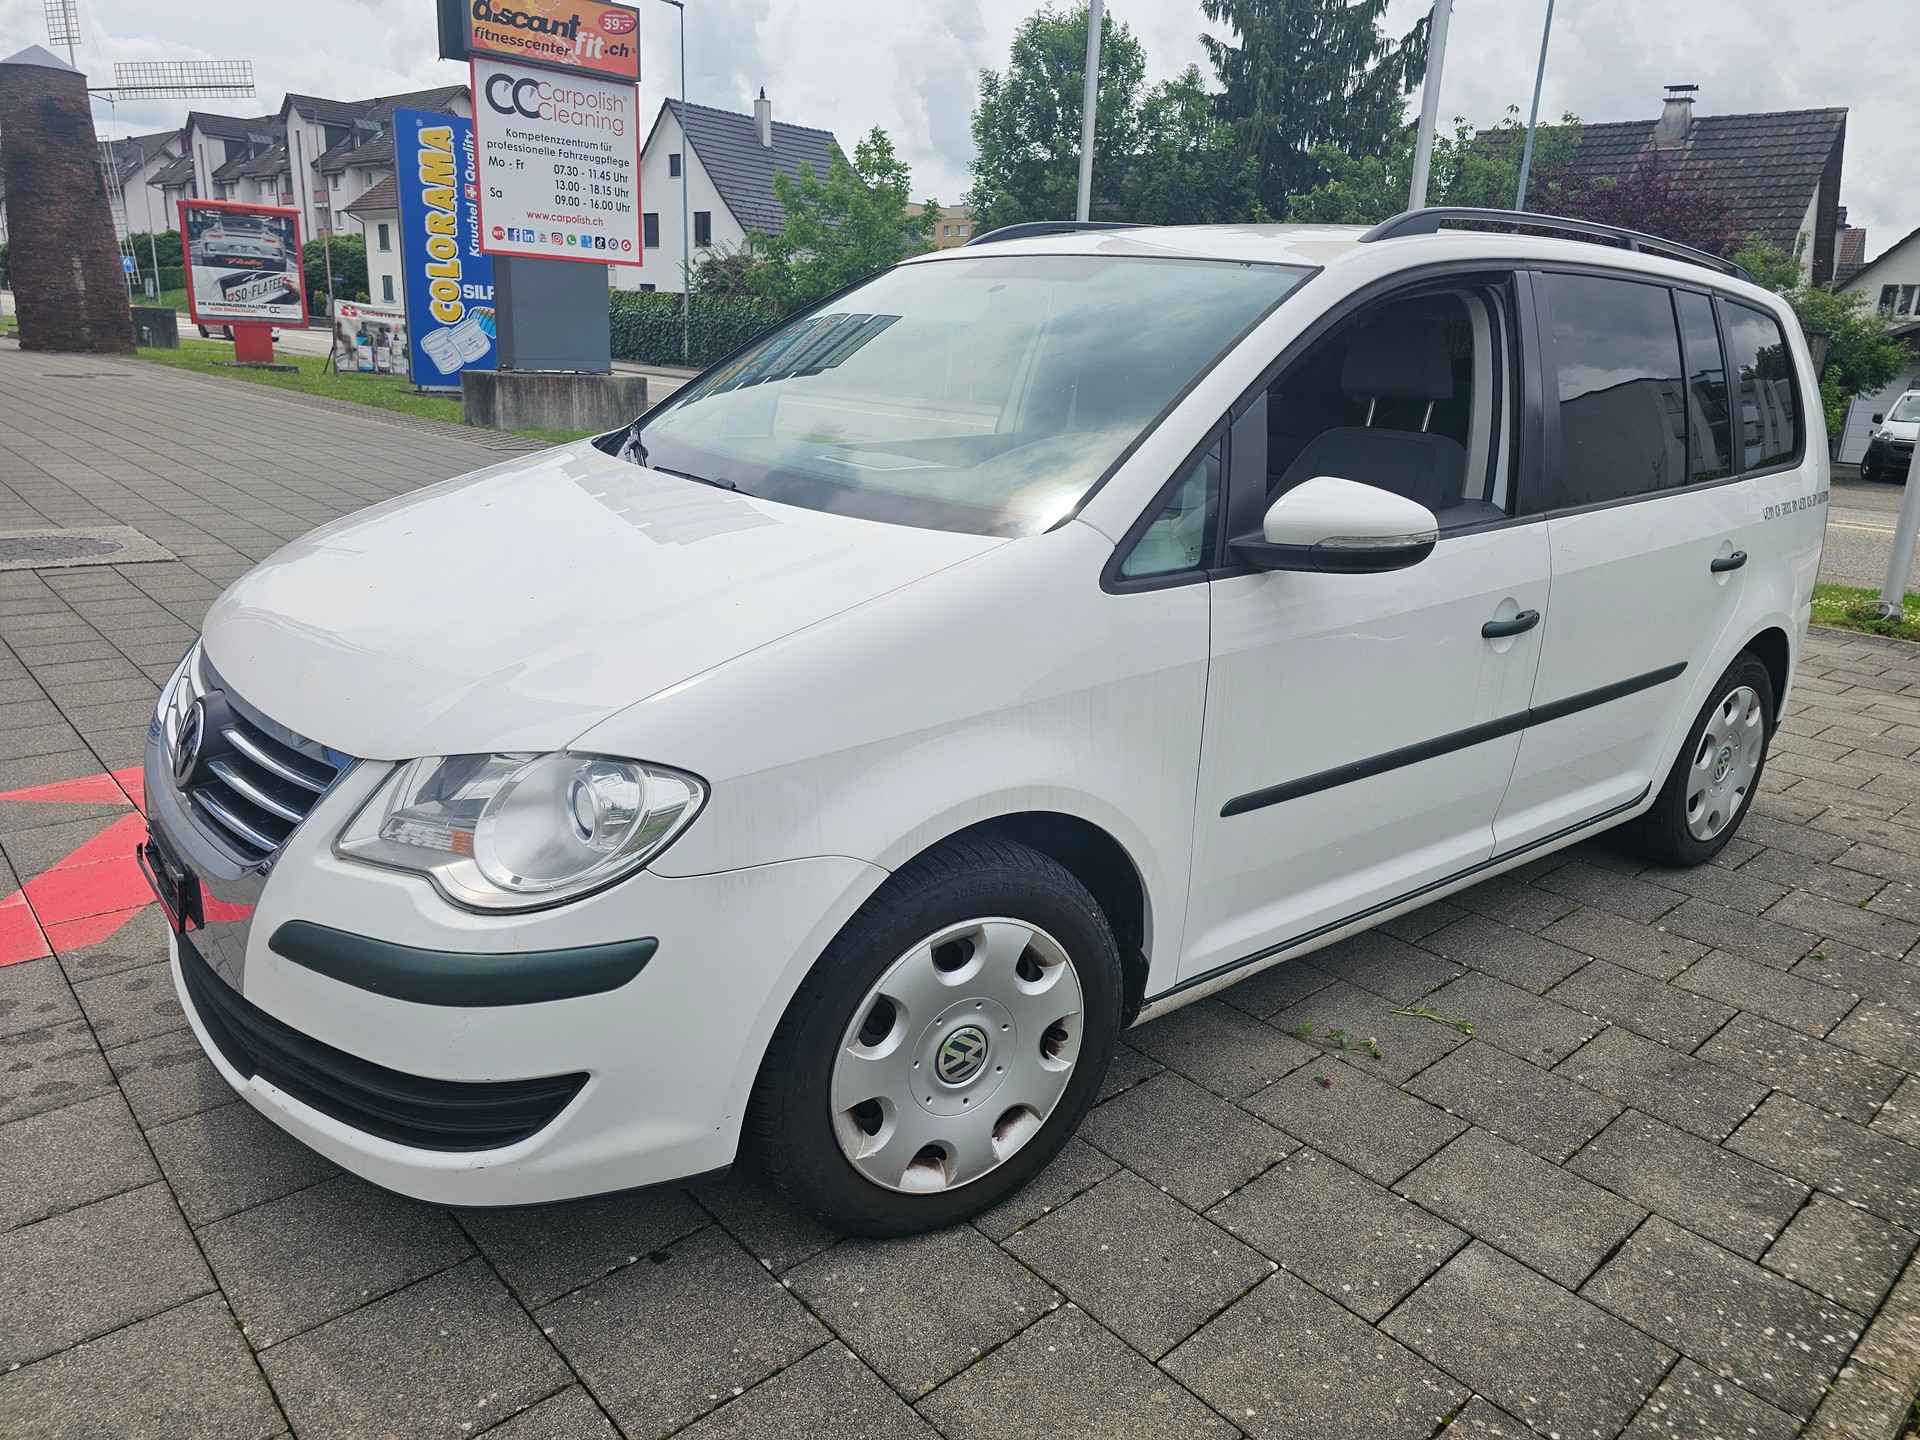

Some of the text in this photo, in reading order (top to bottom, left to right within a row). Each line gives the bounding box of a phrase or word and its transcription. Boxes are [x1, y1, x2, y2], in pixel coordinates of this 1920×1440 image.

[474, 27, 571, 56] fitnesscenter
[536, 81, 624, 113] Carpolish
[537, 101, 624, 136] Cleaning
[505, 128, 612, 152] Kompetenzzentrum für
[487, 141, 630, 168] professionelle Fahrzeugpflege
[488, 155, 505, 167] Mo
[516, 159, 525, 170] Fr
[553, 164, 579, 177] 07.30
[588, 168, 611, 181] 11.45
[613, 172, 629, 184] Uhr
[462, 129, 480, 257] Knuchel Quality
[489, 186, 503, 199] Sa
[555, 180, 580, 192] 13.00
[590, 184, 612, 196] 18.15
[614, 187, 630, 198] Uhr
[555, 194, 580, 207] 09.00
[590, 199, 613, 211] 16.00
[615, 202, 631, 213] Uhr
[418, 126, 463, 323] COLORAMA
[526, 211, 604, 227] www.carpolish.ch
